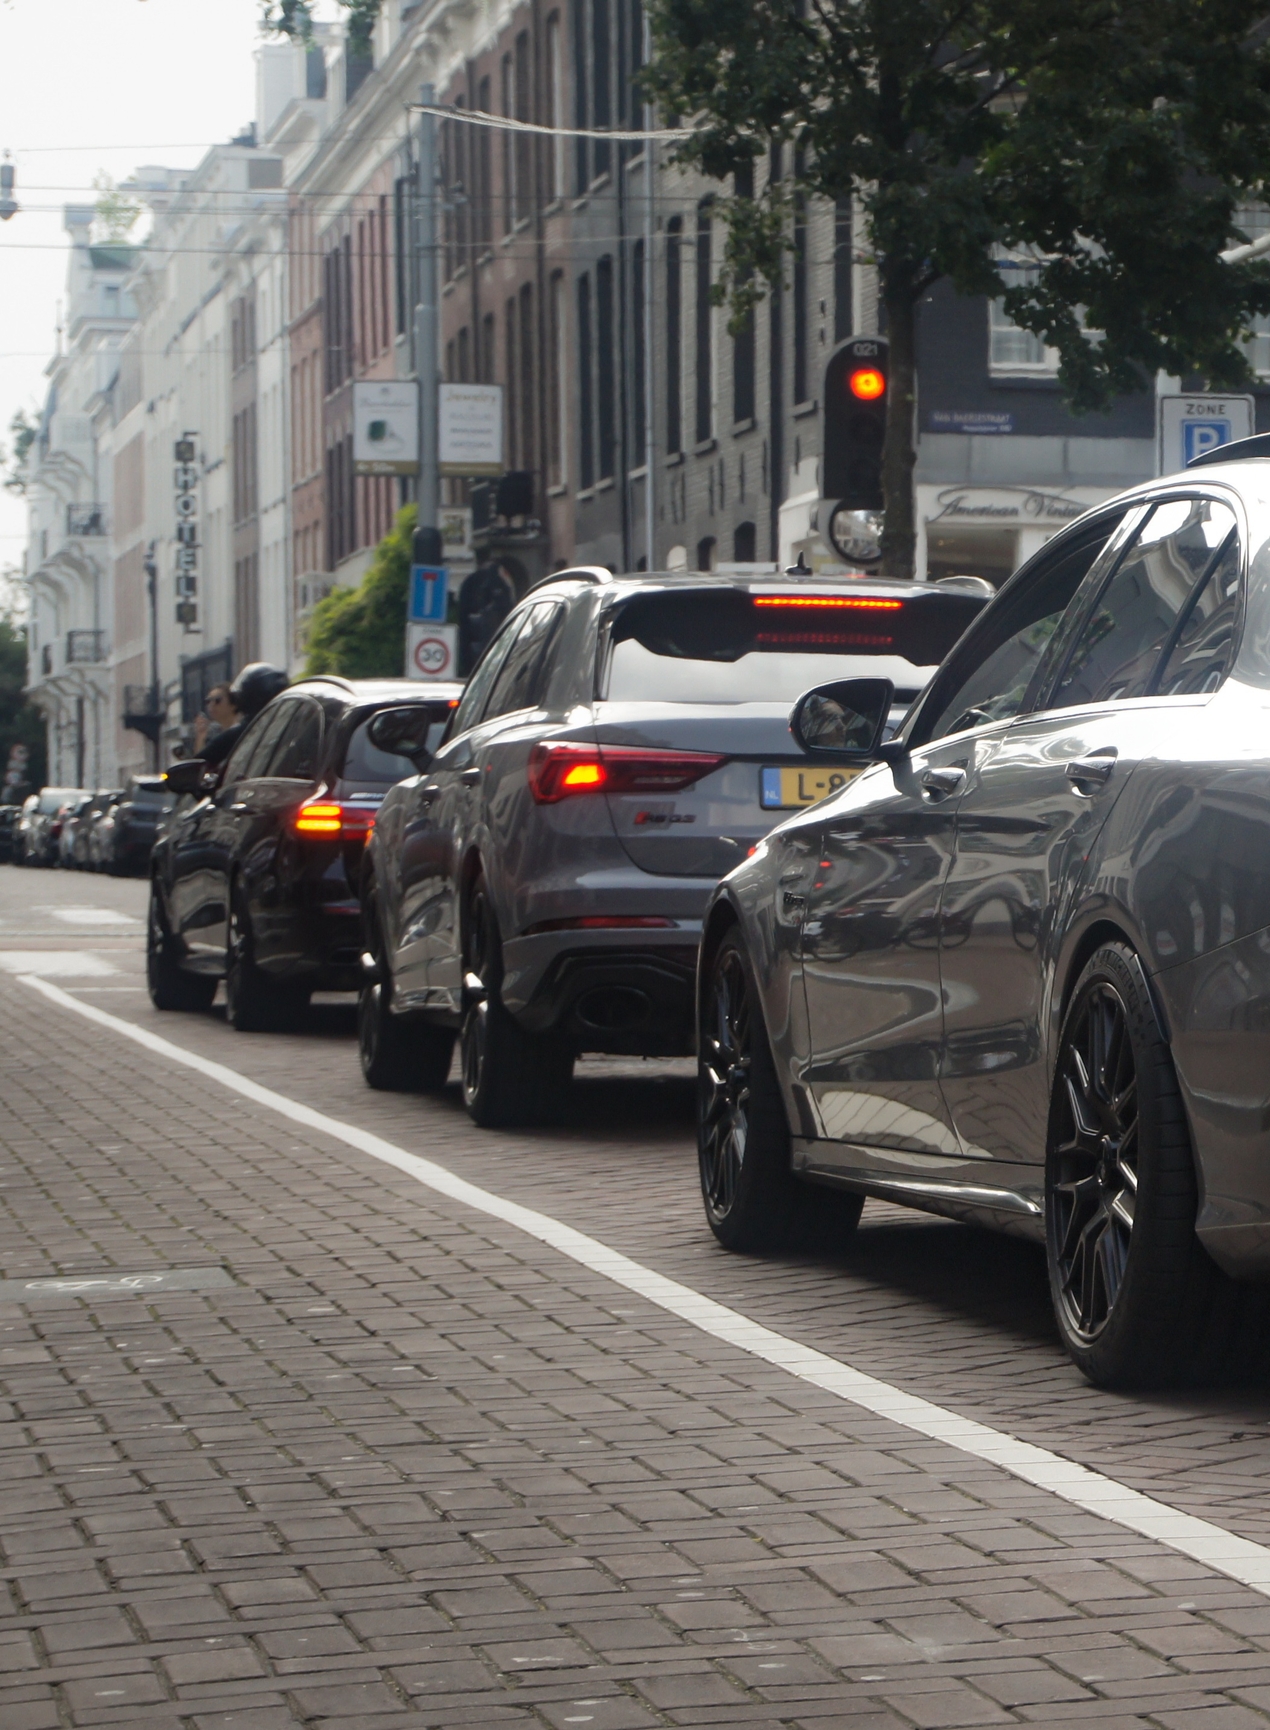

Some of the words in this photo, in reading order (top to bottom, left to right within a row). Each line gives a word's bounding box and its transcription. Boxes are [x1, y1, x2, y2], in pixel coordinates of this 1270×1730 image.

[853, 343, 878, 356] 021
[1186, 403, 1226, 415] ZONE
[1193, 426, 1220, 459] P
[925, 485, 1020, 523] American
[175, 467, 197, 597] HOTEL
[421, 648, 445, 662] 30
